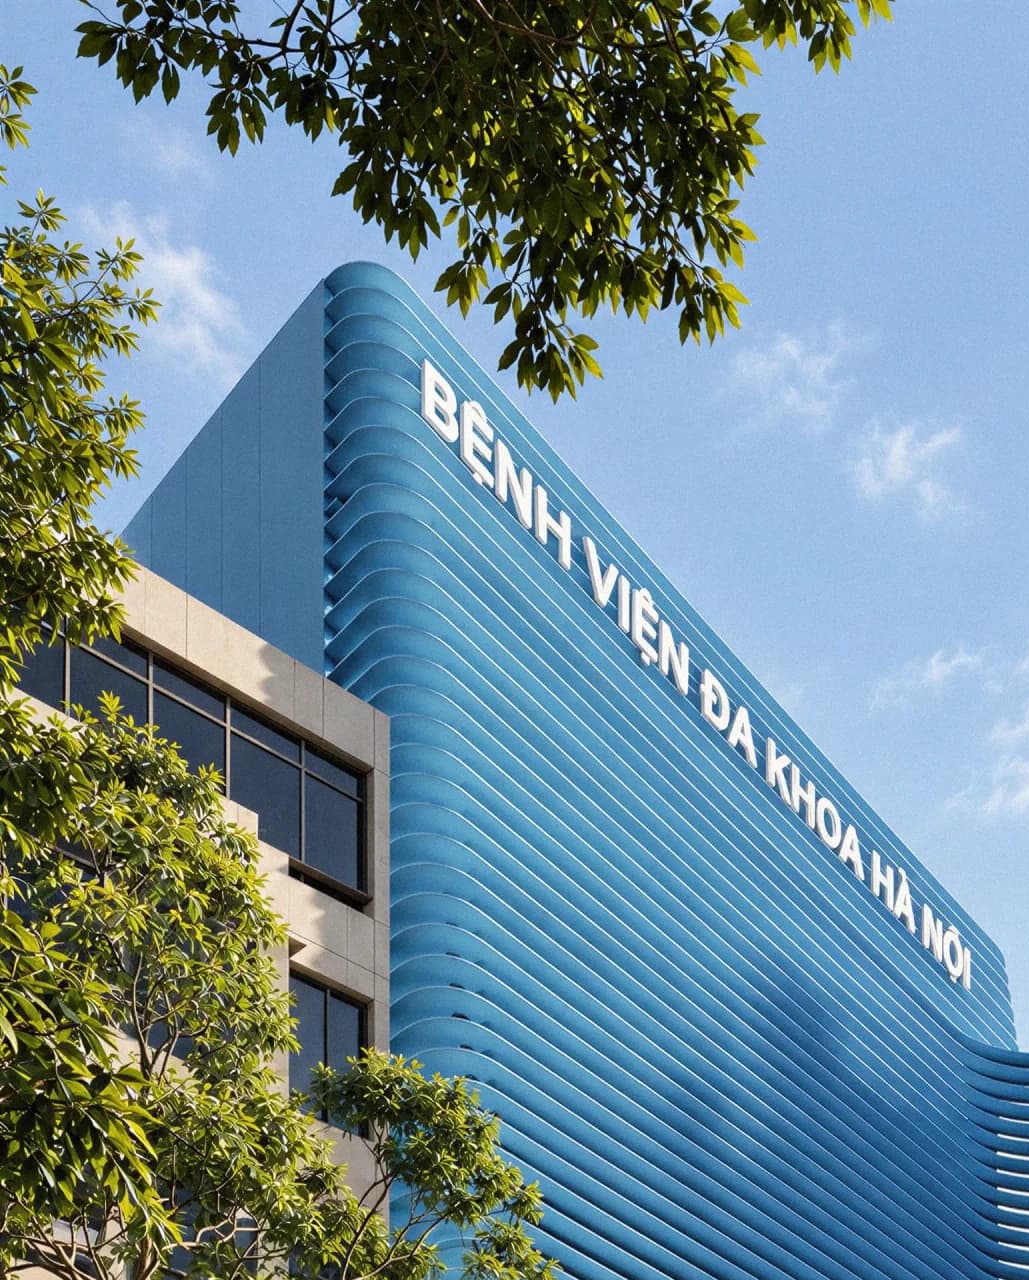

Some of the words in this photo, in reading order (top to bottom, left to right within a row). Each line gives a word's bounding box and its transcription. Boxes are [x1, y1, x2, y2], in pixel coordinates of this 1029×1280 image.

[421, 359, 571, 570] BỆNH
[582, 536, 689, 695] VIỆN
[700, 668, 758, 768] ĐA
[765, 736, 865, 881] KHOA
[870, 850, 916, 934] HÀ
[921, 903, 972, 992] NỘI
